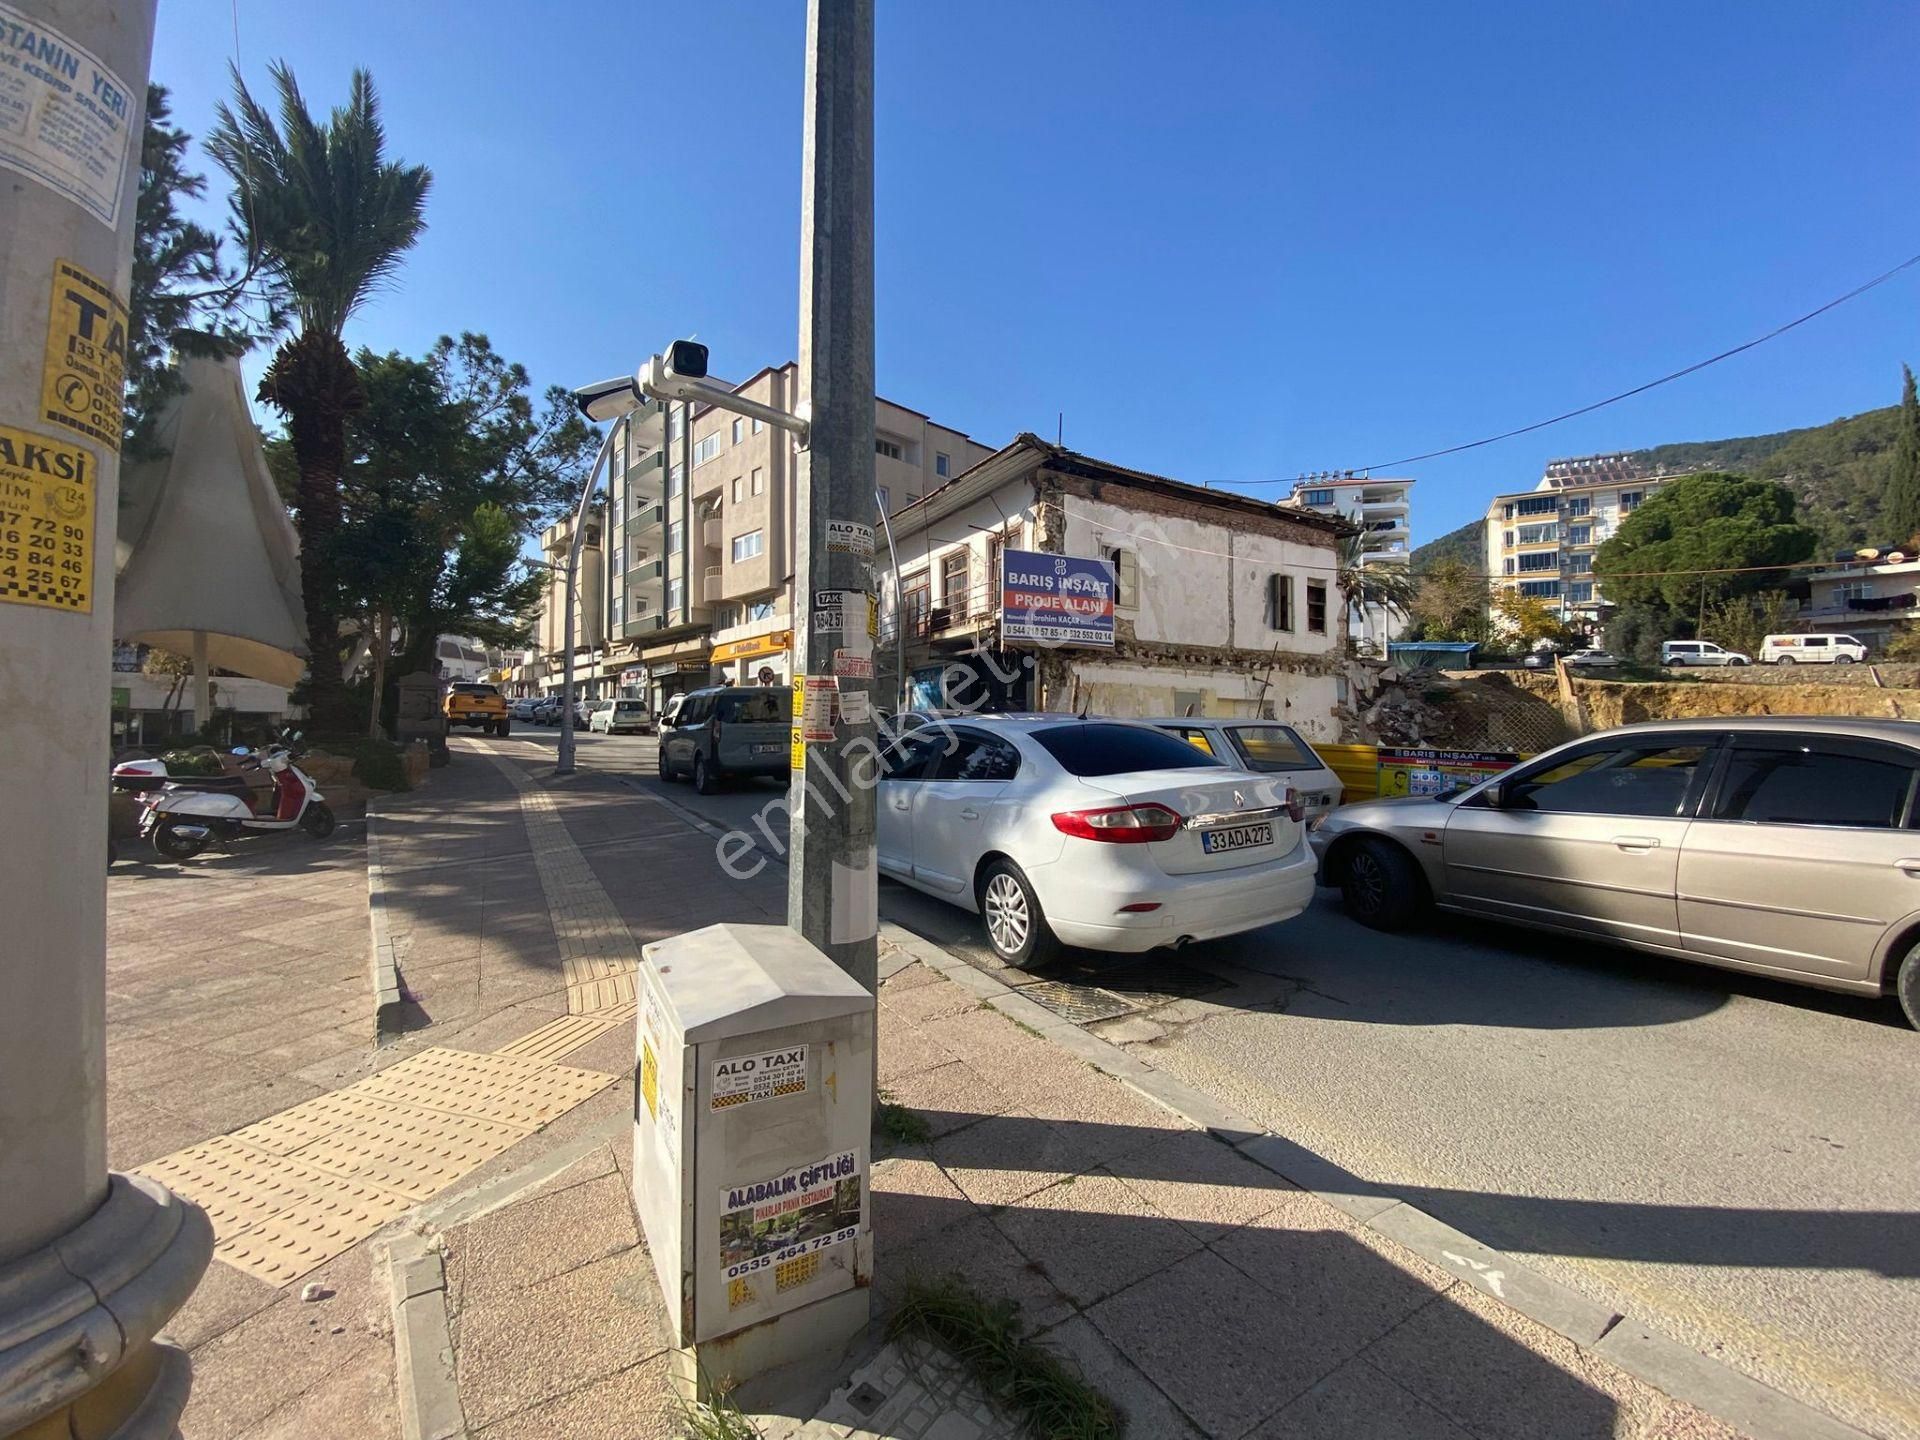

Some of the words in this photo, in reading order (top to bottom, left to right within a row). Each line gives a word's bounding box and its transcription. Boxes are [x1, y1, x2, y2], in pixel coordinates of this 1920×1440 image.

[31, 517, 56, 533] 72
[63, 525, 84, 541] 90
[829, 524, 853, 533] ALO
[29, 534, 56, 550] 20
[63, 542, 83, 557] 33
[28, 552, 55, 567] 84
[61, 559, 82, 573] 46
[27, 569, 53, 584] 25
[60, 575, 81, 590] 67
[1008, 572, 1053, 590] BARIŞ
[821, 594, 843, 604] TAKS
[1015, 594, 1060, 609] PROJE
[1064, 598, 1104, 613] ALANI
[716, 1060, 756, 1077] ALO
[728, 1175, 797, 1209] ALABALIK
[728, 1256, 770, 1278] 0535
[776, 1244, 807, 1260] 464
[812, 1236, 832, 1249] 72
[837, 1228, 855, 1241] 59
